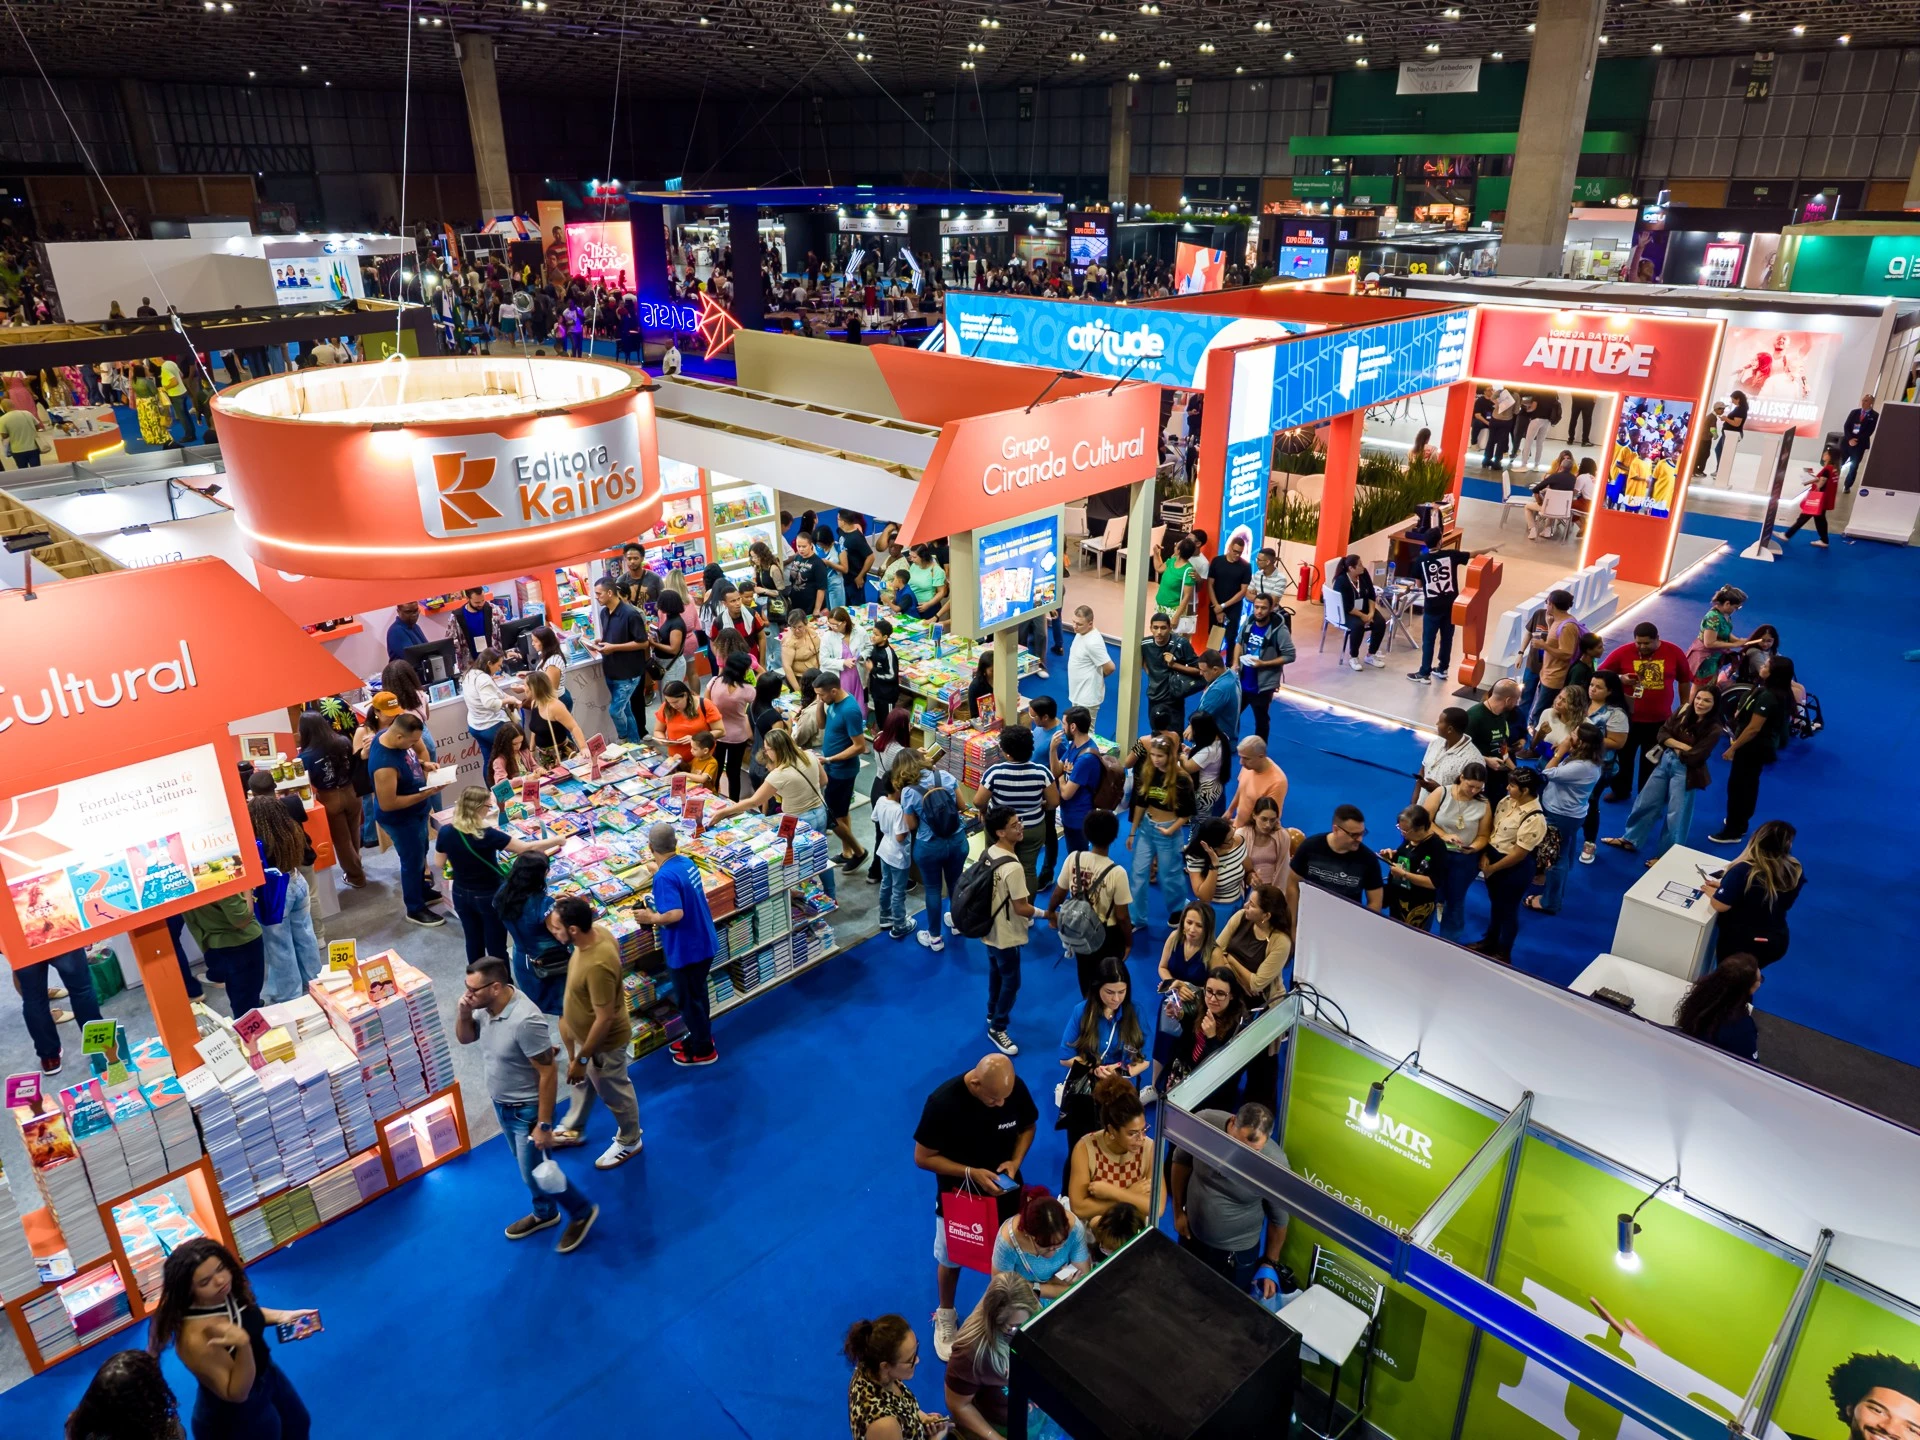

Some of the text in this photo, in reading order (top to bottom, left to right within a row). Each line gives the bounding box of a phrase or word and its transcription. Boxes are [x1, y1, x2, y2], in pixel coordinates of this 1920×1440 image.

[1441, 64, 1473, 72] Bebedouro
[1806, 203, 1827, 213] Maria
[584, 241, 618, 258] TRÊS
[578, 252, 630, 276] GRAÇAS
[1067, 318, 1165, 366] atitude
[1550, 329, 1631, 343] IGREJA BATISTA
[1120, 357, 1162, 371] SCOOL
[1522, 336, 1655, 378] ATITUDE
[1760, 402, 1767, 416] A
[1767, 402, 1790, 417] ESSE
[1790, 404, 1819, 421] AMOR
[1002, 435, 1050, 460] Grupo
[514, 444, 610, 484] Editora
[982, 427, 1145, 496] Ciranda Cultural
[518, 459, 638, 522] Kairós
[455, 760, 481, 776] rma
[79, 788, 142, 813] Fortaleça
[146, 782, 154, 794] a
[157, 777, 178, 792] sua
[181, 772, 193, 787] fé
[81, 805, 129, 826] através
[132, 798, 150, 814] da
[152, 786, 197, 808] leitura.
[192, 831, 235, 853] Olive
[138, 863, 186, 885] peregrino
[162, 877, 189, 892] jovens
[168, 871, 187, 883] para
[76, 887, 85, 896] O
[78, 881, 130, 903] PEREGRINO
[207, 1040, 227, 1057] papo
[211, 1048, 233, 1064] Deus
[1345, 1096, 1433, 1161] IMR
[1345, 1119, 1431, 1170] Centro Universitário
[1304, 1167, 1373, 1218] Vocação
[1425, 1242, 1454, 1264] era
[949, 1225, 984, 1242] Embracon
[1322, 1275, 1345, 1293] com
